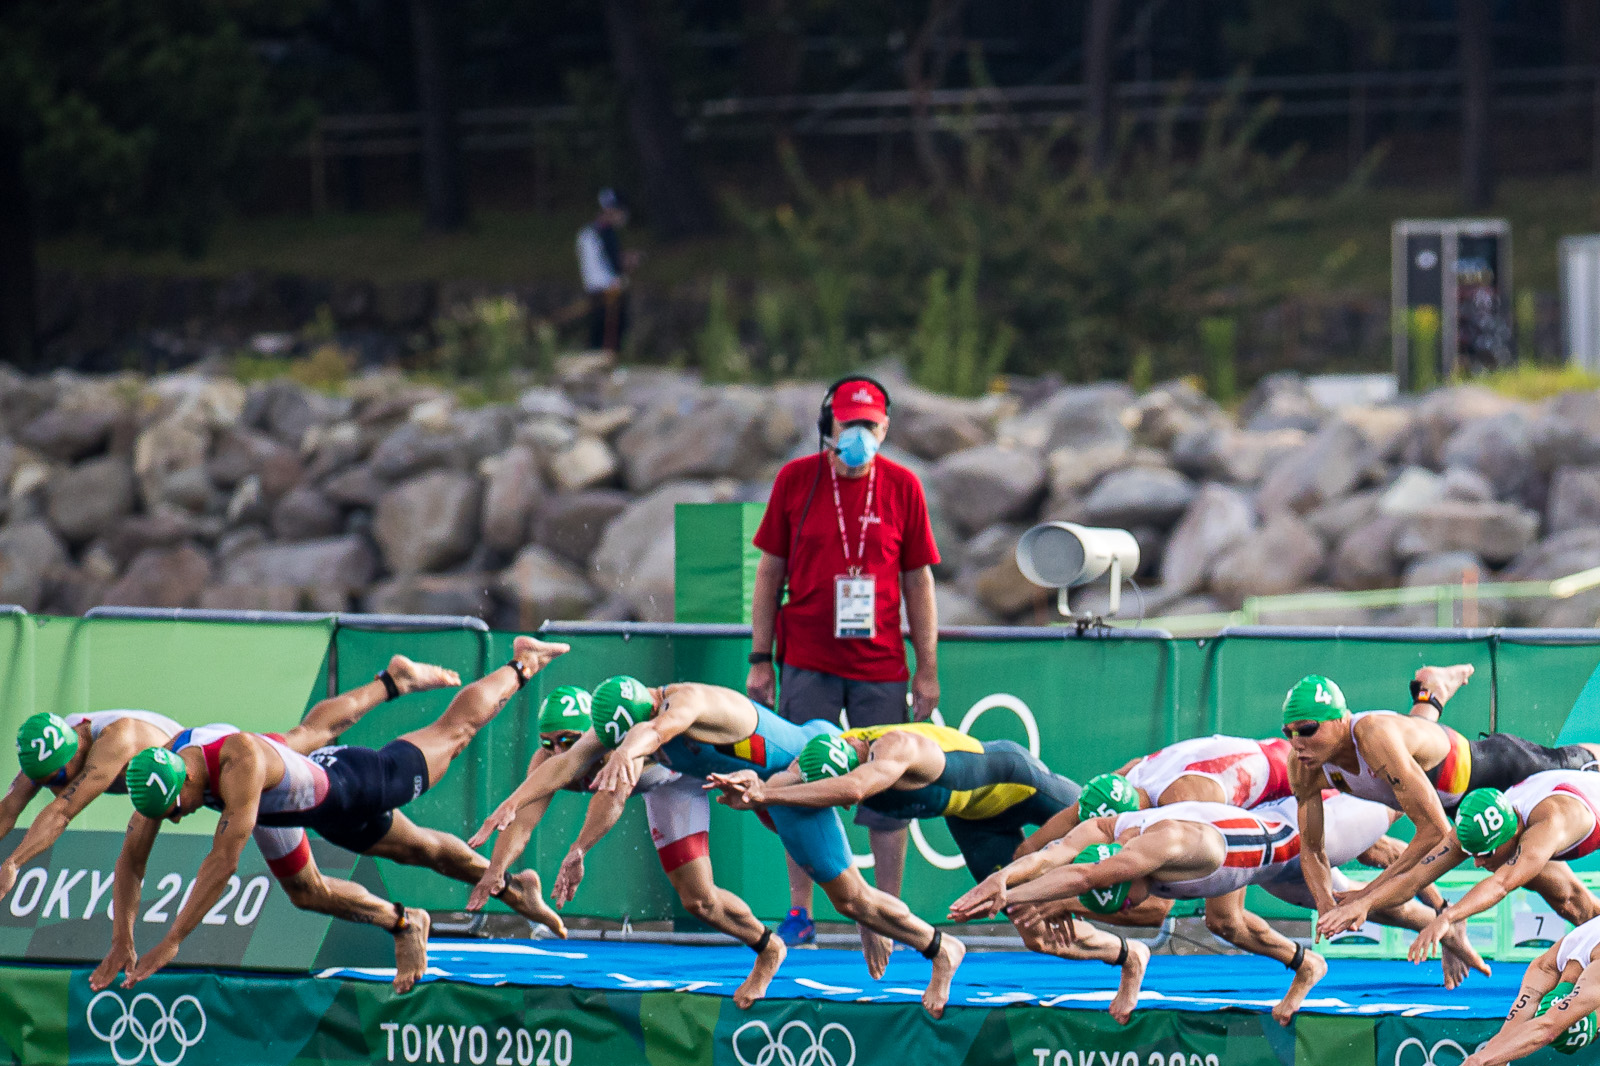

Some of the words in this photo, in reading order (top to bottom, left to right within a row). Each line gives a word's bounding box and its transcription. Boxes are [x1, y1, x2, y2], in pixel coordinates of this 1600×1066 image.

[560, 692, 592, 717] 20
[1315, 683, 1332, 705] 4
[605, 705, 634, 744] 27
[31, 726, 65, 762] 22
[146, 772, 168, 796] 7
[1473, 805, 1505, 837] 18
[1534, 916, 1545, 936] 7
[380, 1023, 488, 1065] TOKYO
[1565, 1015, 1590, 1047] 55
